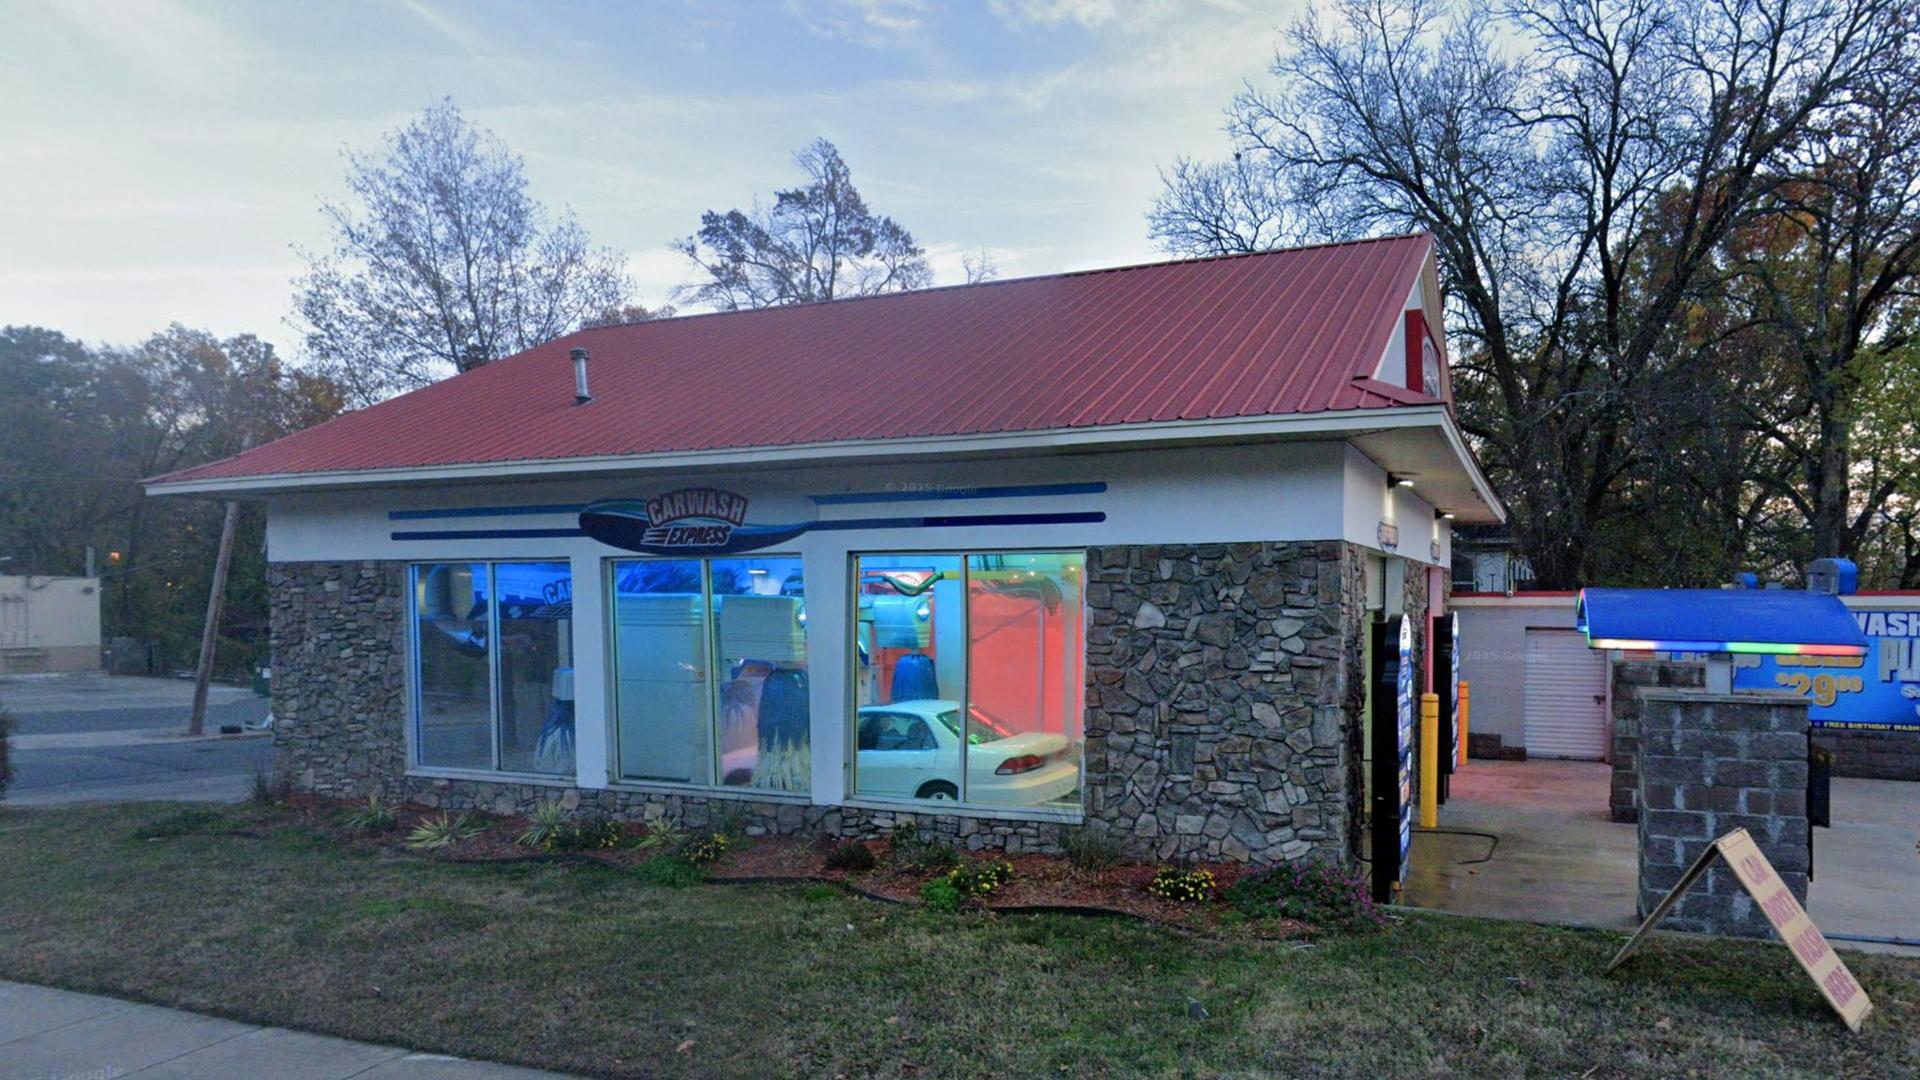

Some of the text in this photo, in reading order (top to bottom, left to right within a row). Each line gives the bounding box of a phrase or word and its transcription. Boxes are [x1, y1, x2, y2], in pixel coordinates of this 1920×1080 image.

[647, 490, 746, 524] CARWASH
[667, 526, 731, 546] EXPRESS
[1848, 722, 1891, 731] BIRTHDAY
[1822, 965, 1858, 1007] HERE
